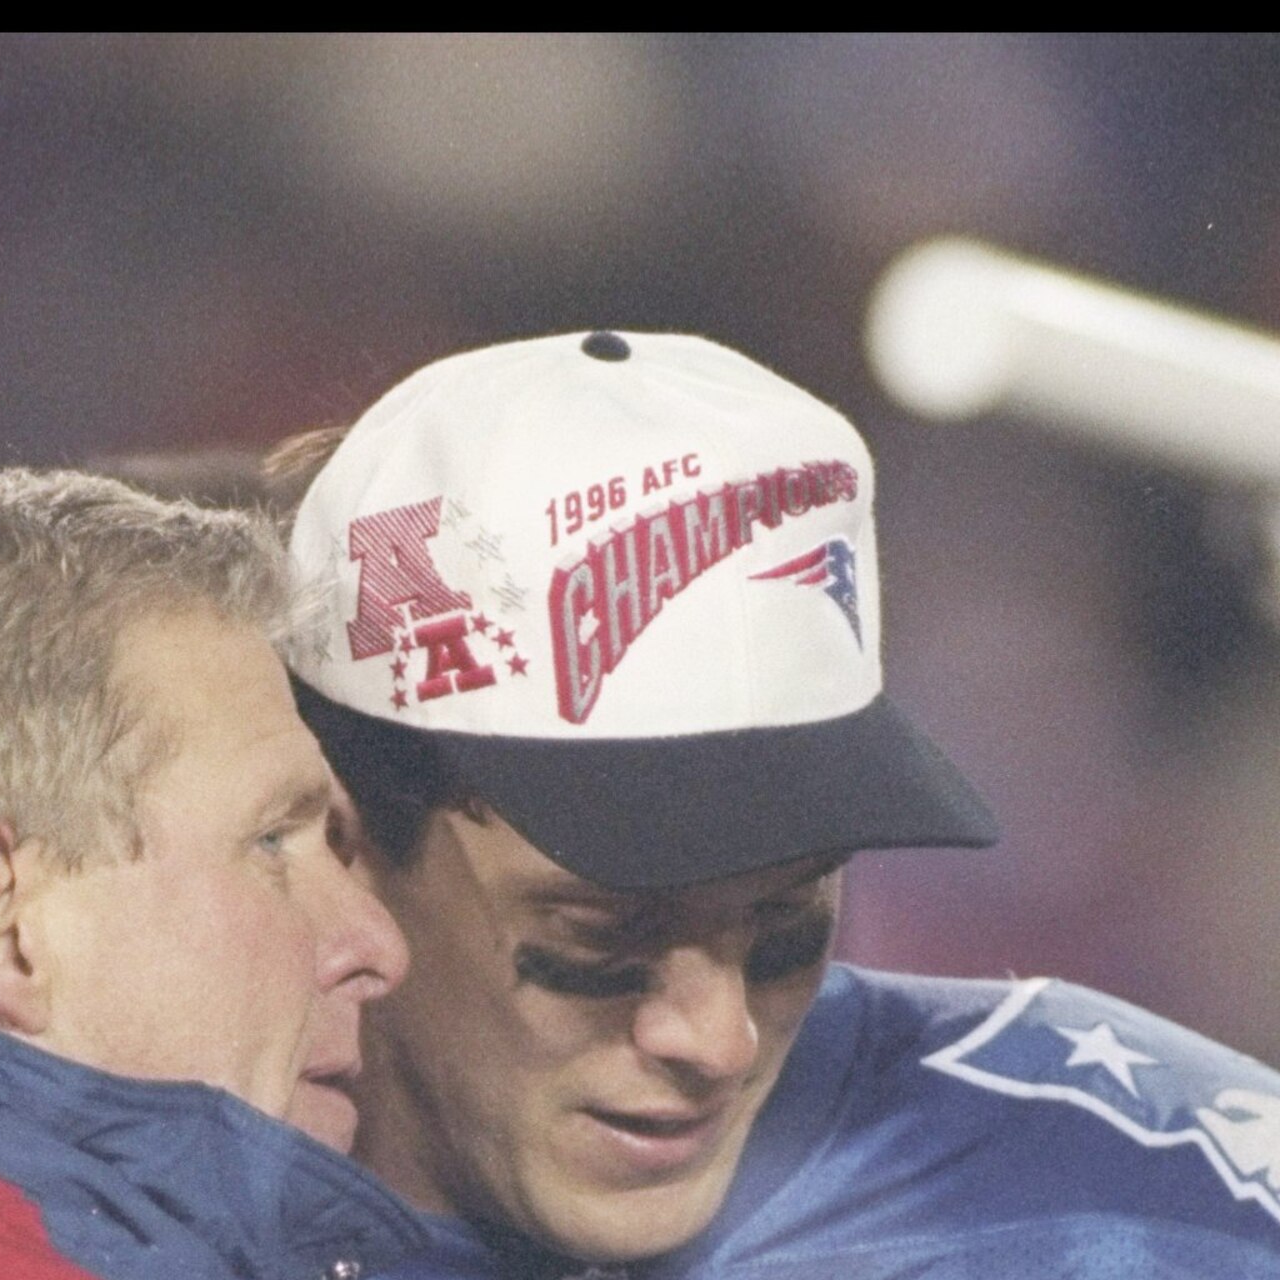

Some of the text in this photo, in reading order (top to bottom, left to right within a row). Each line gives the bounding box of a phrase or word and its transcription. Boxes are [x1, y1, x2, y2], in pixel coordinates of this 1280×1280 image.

[545, 453, 701, 547] 1996 AFC
[548, 459, 859, 725] CHAMPIONS
